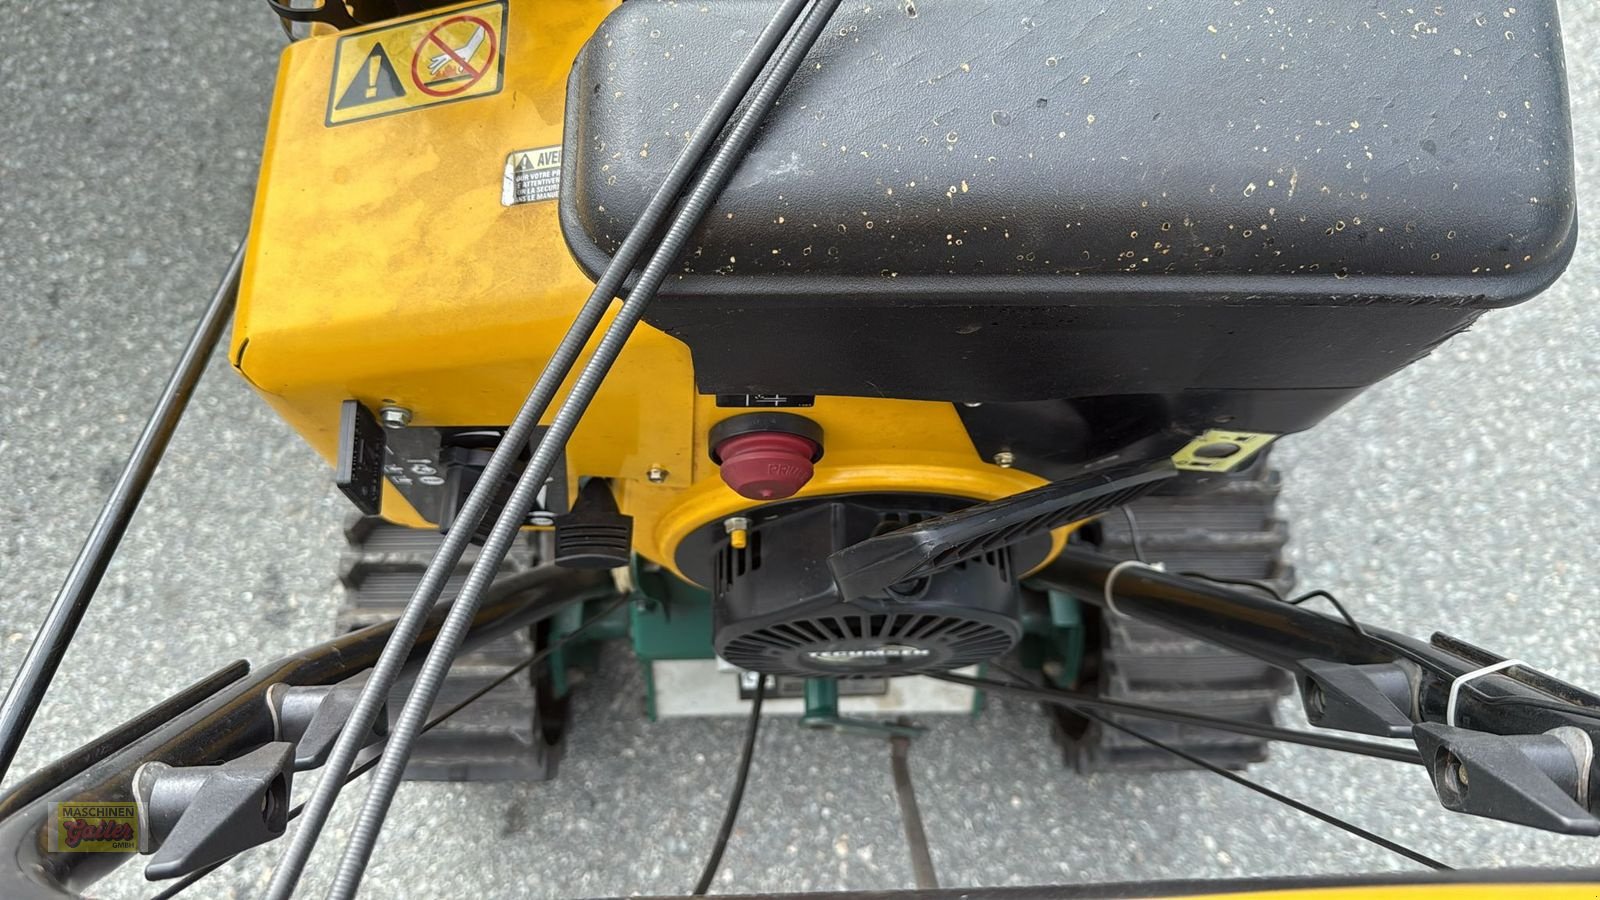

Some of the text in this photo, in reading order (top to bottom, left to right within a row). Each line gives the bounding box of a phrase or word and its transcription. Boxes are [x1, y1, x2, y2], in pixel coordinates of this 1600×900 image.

[530, 171, 551, 180] VOTRE
[527, 187, 536, 195] LA
[527, 193, 536, 201] LE
